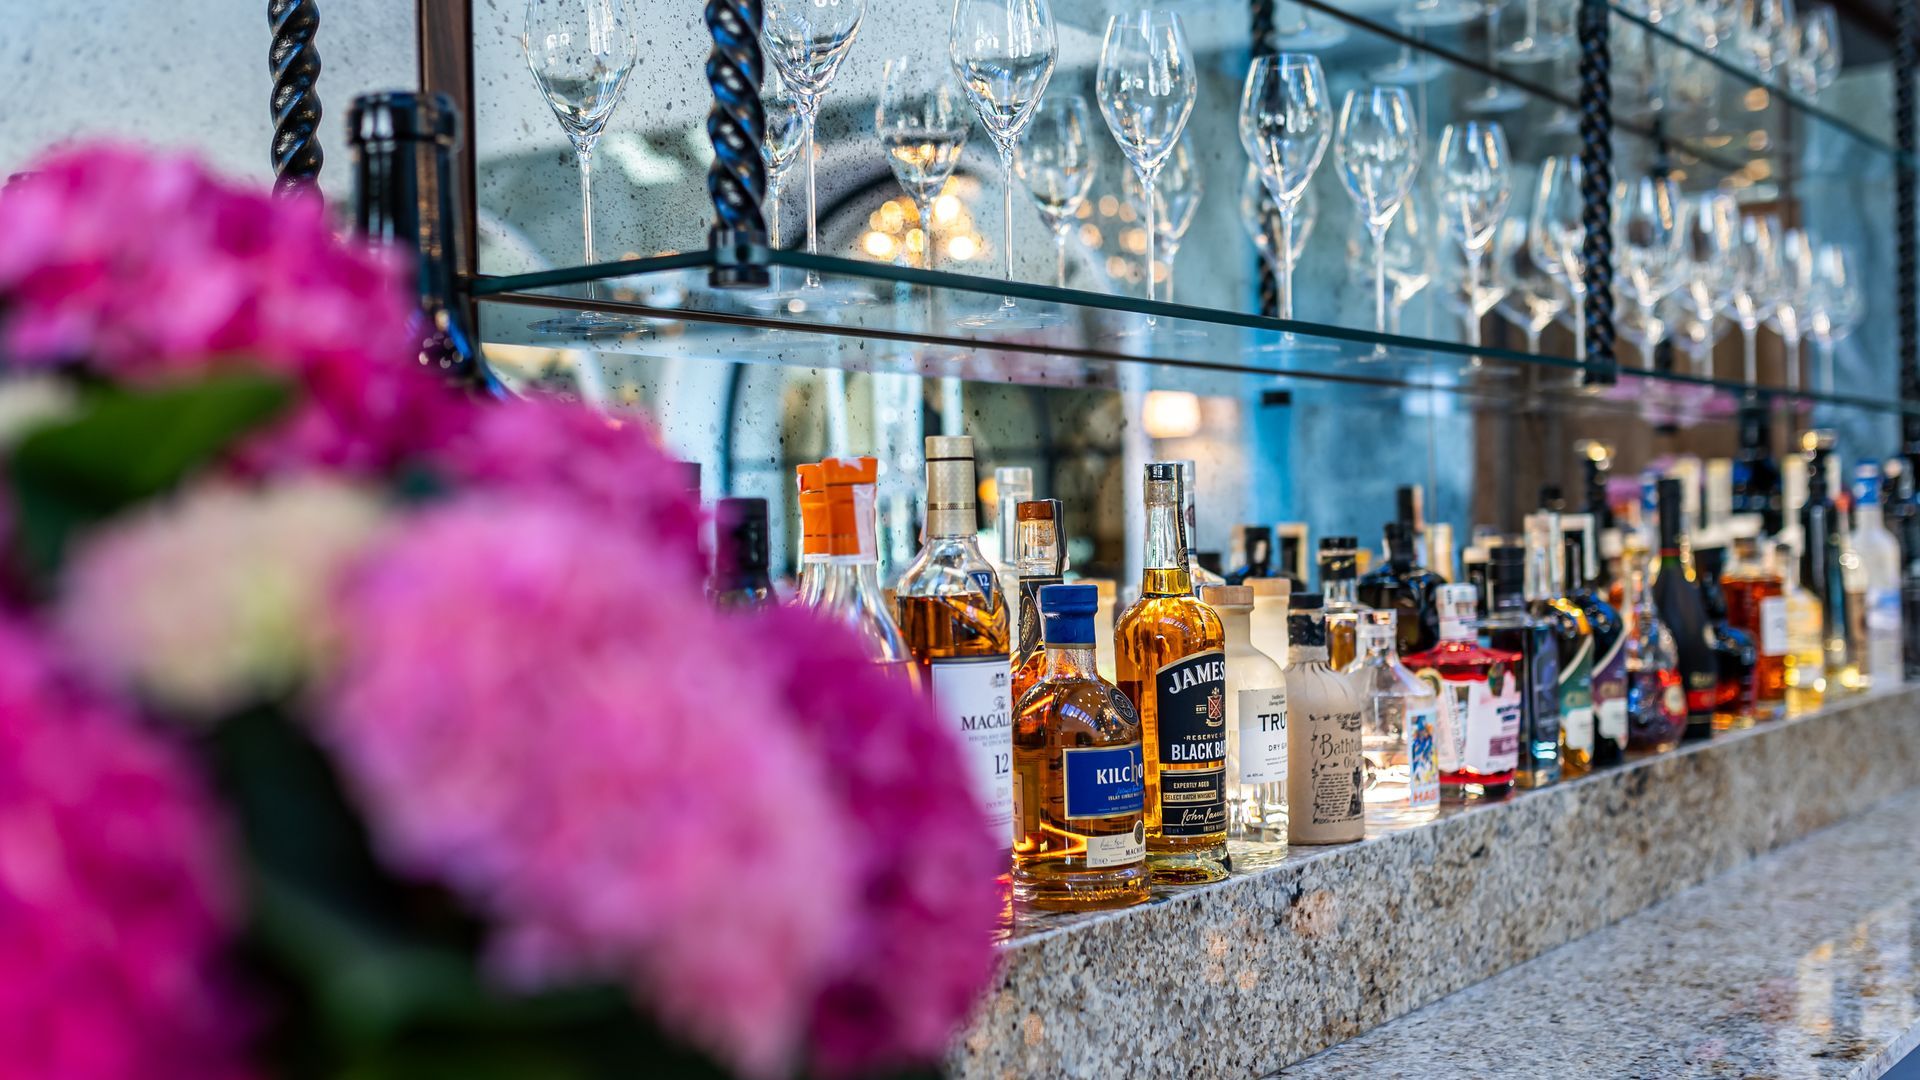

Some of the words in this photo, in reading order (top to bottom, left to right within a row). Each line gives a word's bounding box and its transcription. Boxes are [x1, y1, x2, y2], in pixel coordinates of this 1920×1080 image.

[977, 574, 990, 587] 12
[1171, 742, 1213, 761] BLACK
[1268, 744, 1280, 752] DRY
[995, 753, 1009, 776] 12
